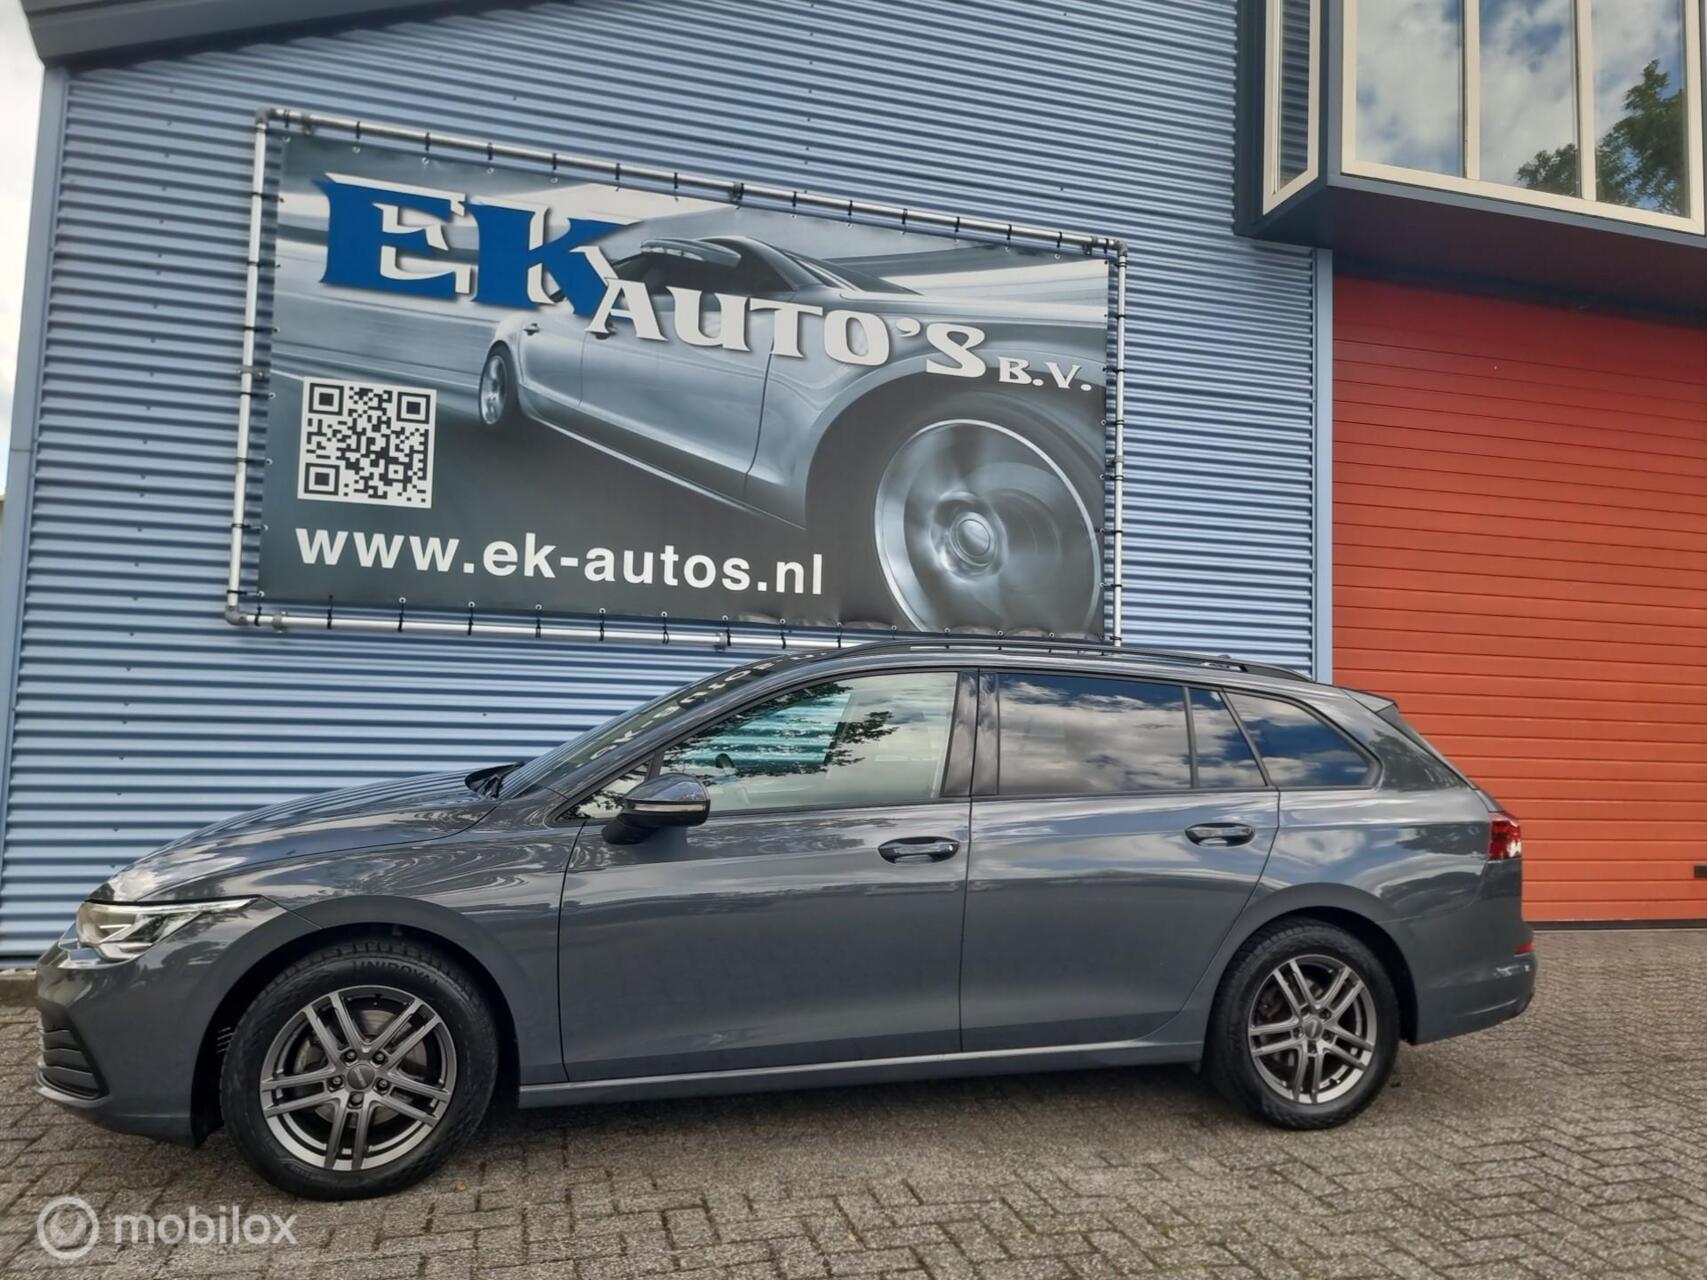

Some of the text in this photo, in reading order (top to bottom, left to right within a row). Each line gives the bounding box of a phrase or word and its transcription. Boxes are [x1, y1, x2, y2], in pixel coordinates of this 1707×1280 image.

[311, 172, 1093, 392] EK AUTO'S B.V.
[295, 527, 823, 595] www.ek-autos.nl
